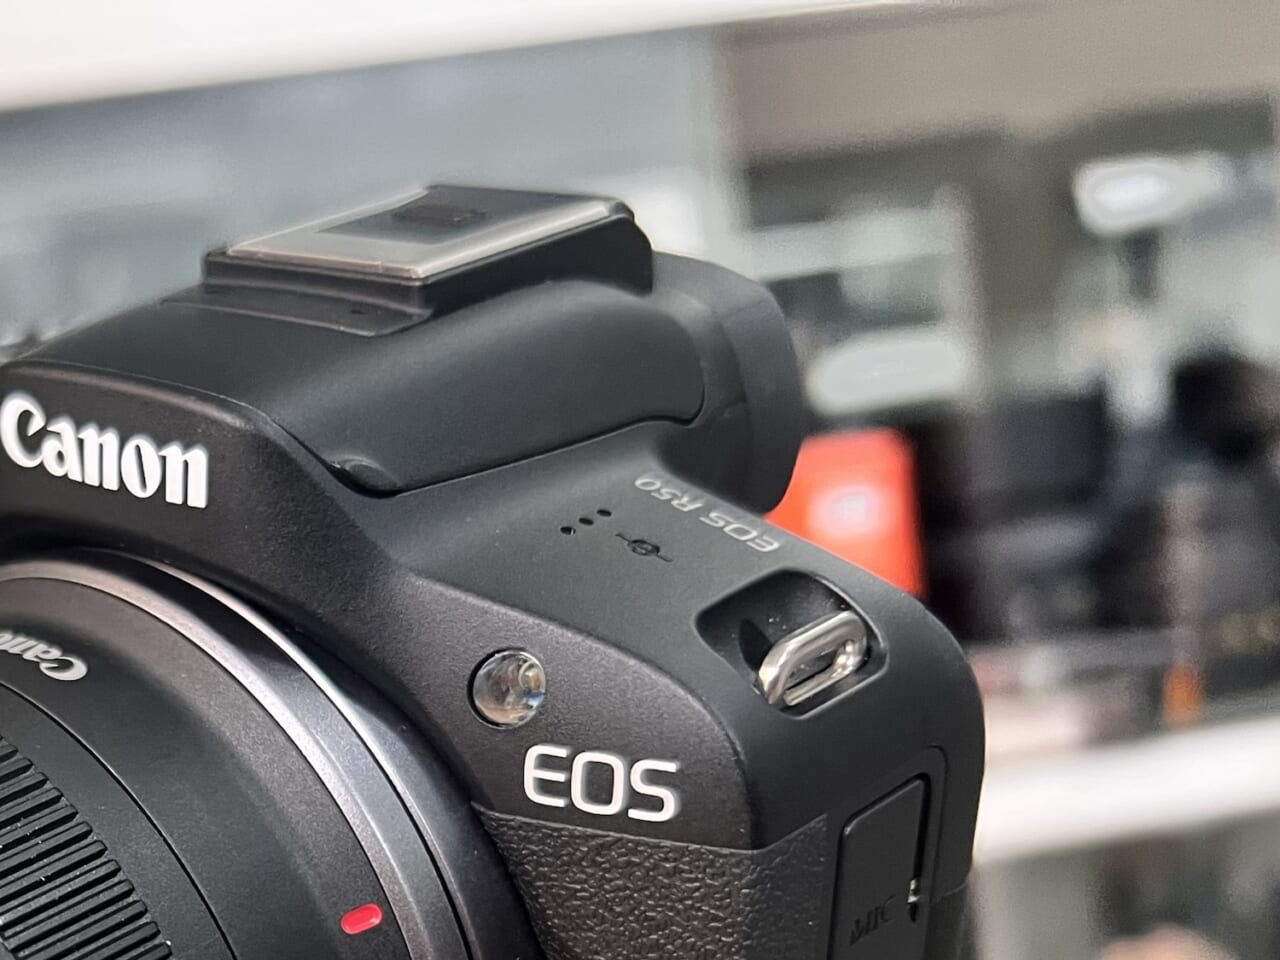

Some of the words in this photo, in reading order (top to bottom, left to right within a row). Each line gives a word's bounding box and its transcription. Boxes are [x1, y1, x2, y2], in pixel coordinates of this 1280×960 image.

[634, 475, 705, 512] R50
[700, 510, 781, 552] EOS
[522, 744, 680, 822] EOS
